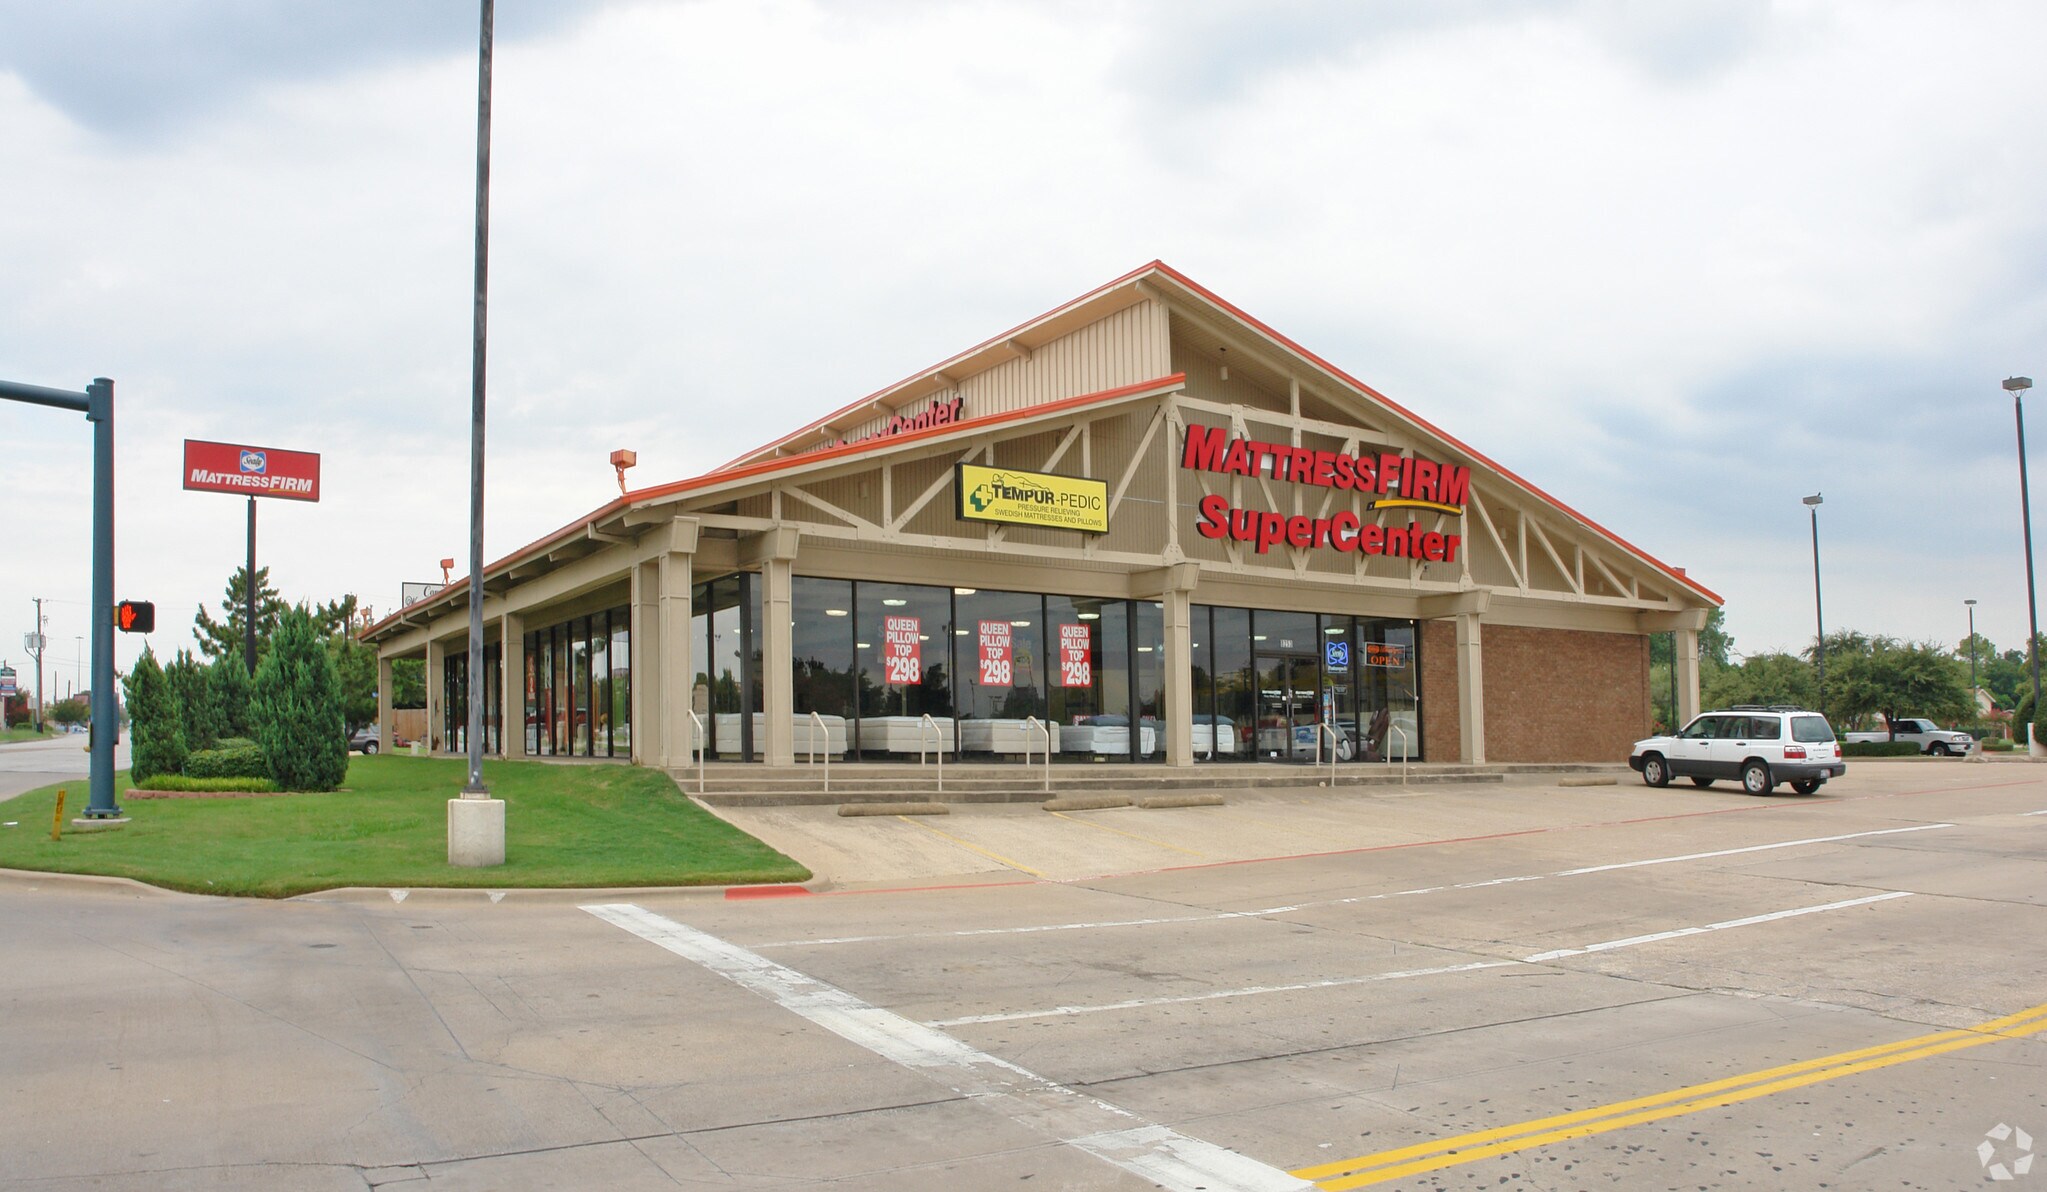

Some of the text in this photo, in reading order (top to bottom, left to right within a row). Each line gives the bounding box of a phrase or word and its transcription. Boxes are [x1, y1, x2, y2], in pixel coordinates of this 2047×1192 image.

[244, 454, 262, 467] Sealy
[1017, 503, 1081, 516] PRESSURE RELIEVING
[994, 508, 1103, 527] SWEDISH MATTRESSES AND PILLOWS
[1196, 495, 1462, 562] SuperCenter
[887, 618, 918, 632] QUEEN
[980, 622, 1009, 636] QUEEN
[1061, 625, 1089, 638] QUEEN
[886, 631, 919, 645] PILLOW
[979, 634, 1010, 648] PILLOW
[1061, 637, 1090, 650] PILLOW
[894, 644, 913, 657] TOP
[987, 647, 1004, 660] TOP
[1068, 649, 1085, 662] TOP
[1370, 655, 1400, 666] OPEN
[886, 656, 920, 683] $298
[980, 659, 1011, 684] $298
[1061, 661, 1091, 685] $298
